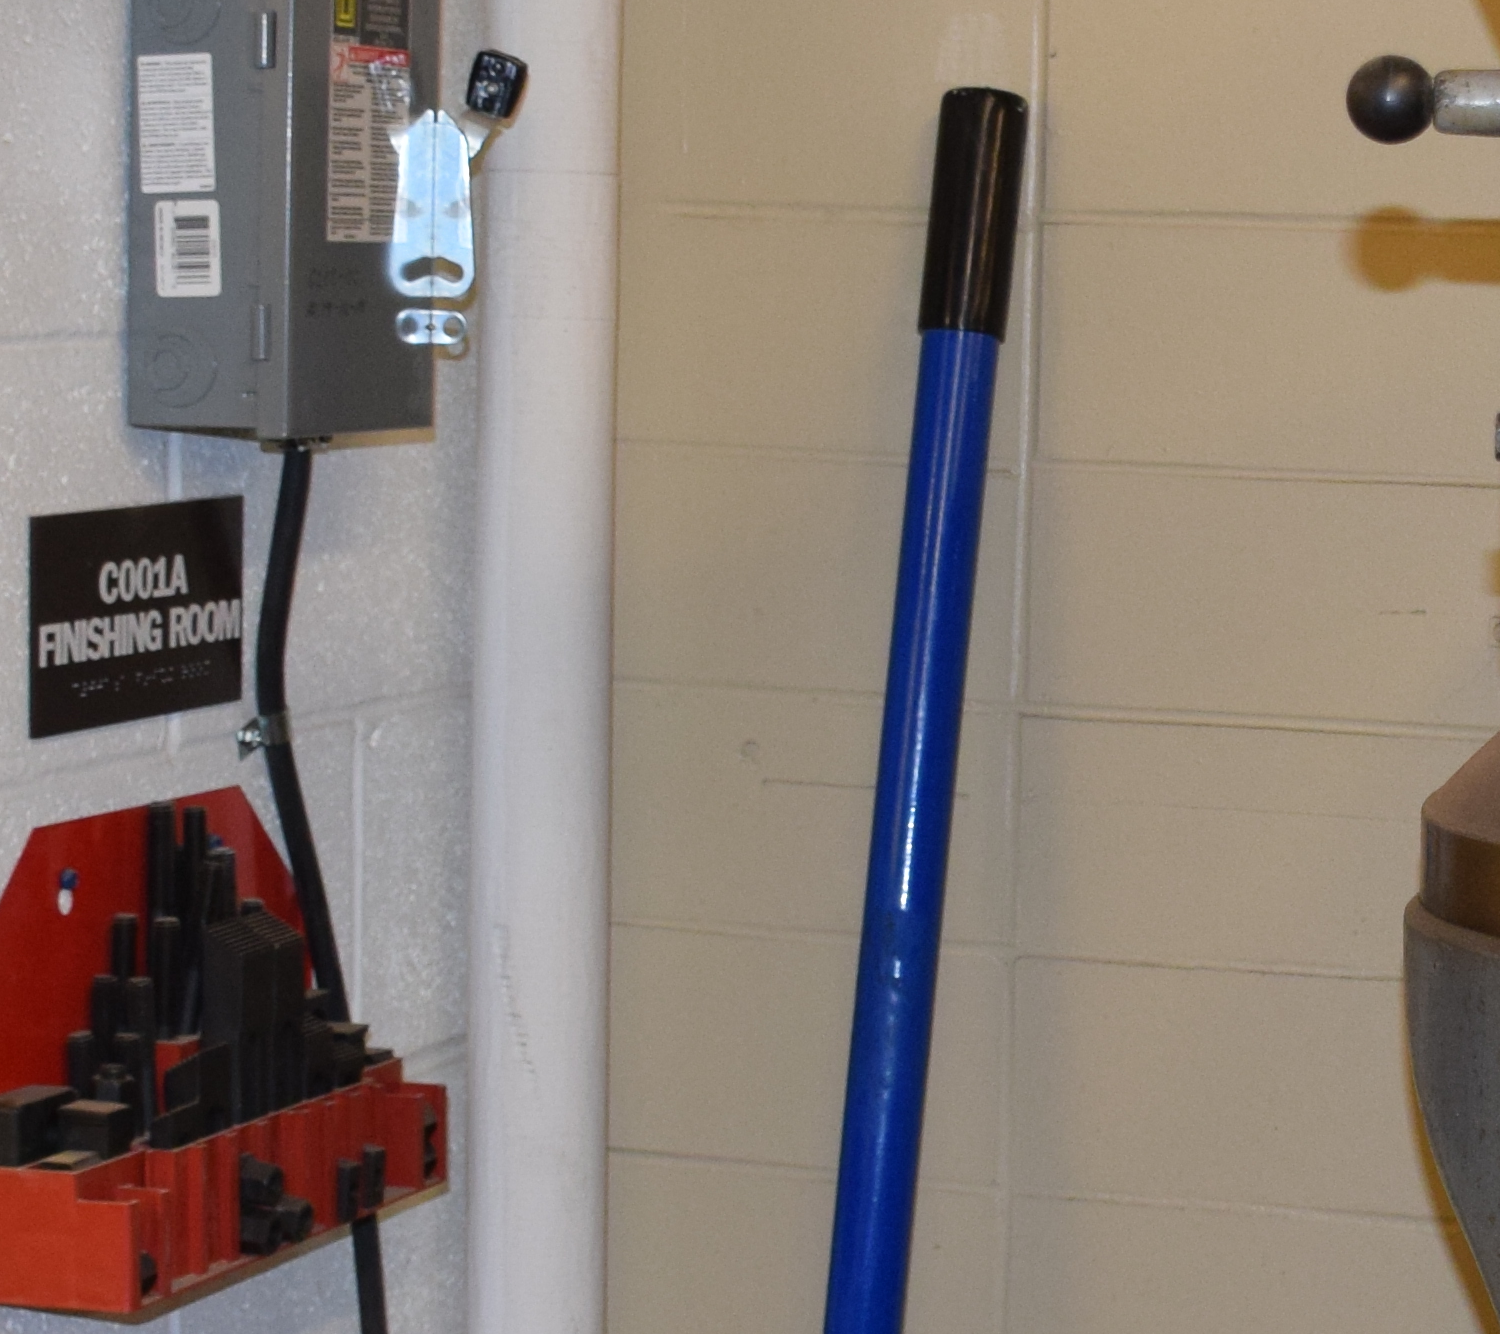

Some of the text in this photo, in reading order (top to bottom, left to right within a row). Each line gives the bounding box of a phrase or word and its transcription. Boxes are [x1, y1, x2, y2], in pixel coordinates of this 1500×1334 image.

[99, 554, 189, 604] C001A
[39, 598, 241, 668] FINISHING ROOM
